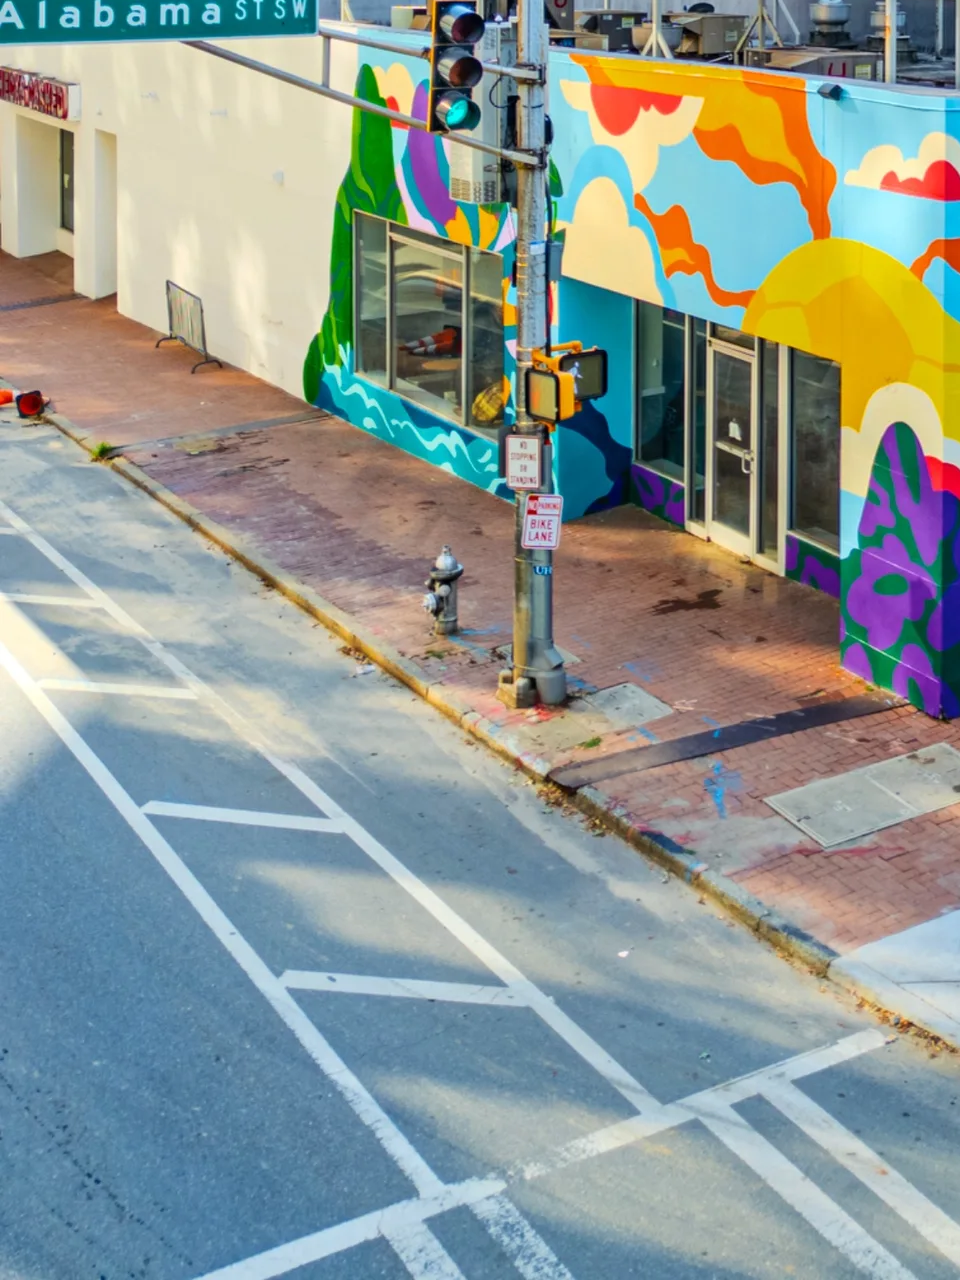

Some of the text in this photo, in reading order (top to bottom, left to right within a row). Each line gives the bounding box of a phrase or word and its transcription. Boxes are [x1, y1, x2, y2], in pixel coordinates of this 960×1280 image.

[510, 475, 537, 485] STANDING
[530, 519, 552, 530] BIKE
[528, 531, 552, 541] LANE
